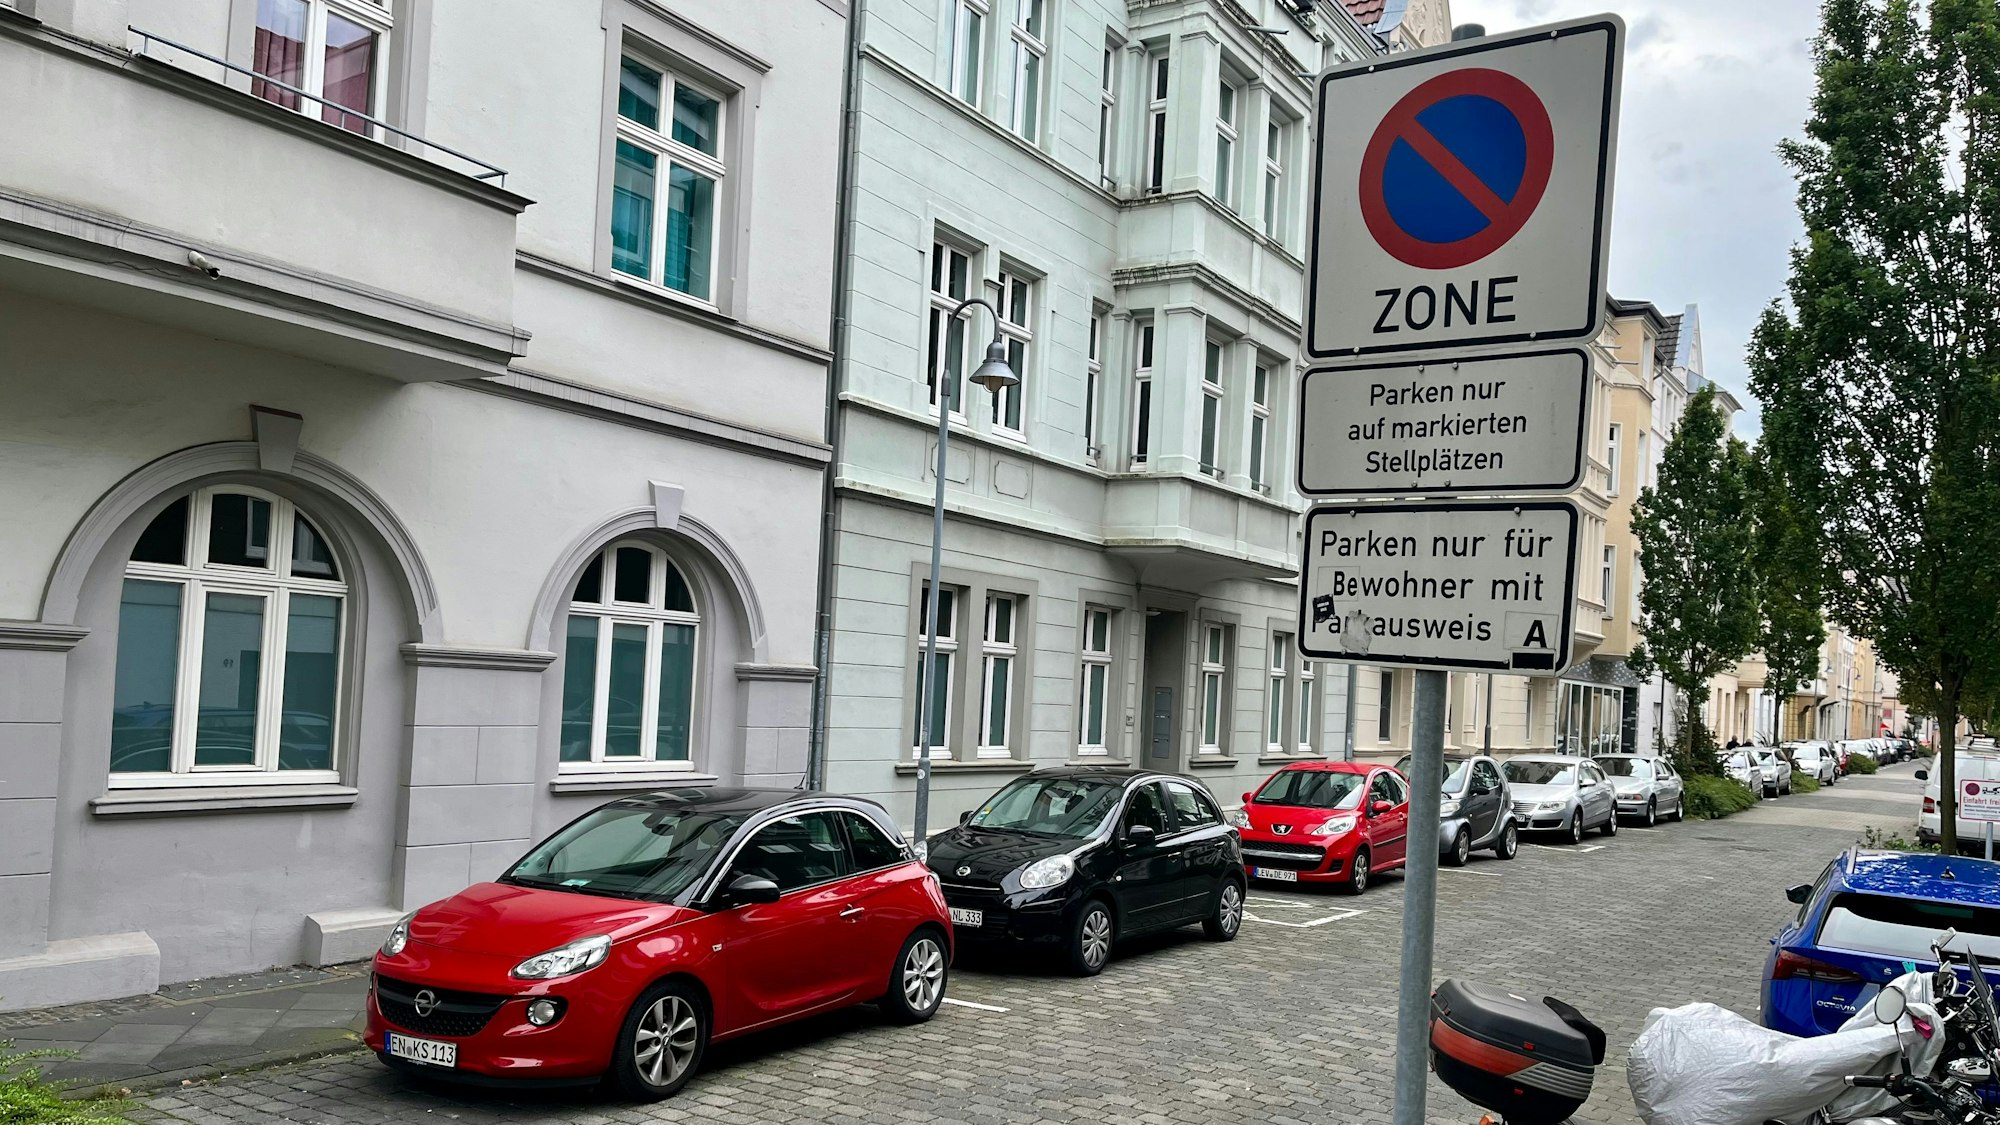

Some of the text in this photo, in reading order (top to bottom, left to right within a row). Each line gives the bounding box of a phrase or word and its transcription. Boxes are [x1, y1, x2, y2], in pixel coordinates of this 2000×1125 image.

[1373, 276, 1518, 333] ZONE
[1370, 380, 1506, 406] Parken nur
[1348, 413, 1527, 441] auf markierten
[1366, 449, 1503, 478] Stellplätzen
[1320, 529, 1553, 558] Parken nur für
[1333, 571, 1544, 602] Bewohner mit
[1522, 619, 1548, 649] A
[1283, 872, 1296, 881] 971
[952, 910, 981, 924] NL 333
[391, 1036, 454, 1064] EN KS 113
